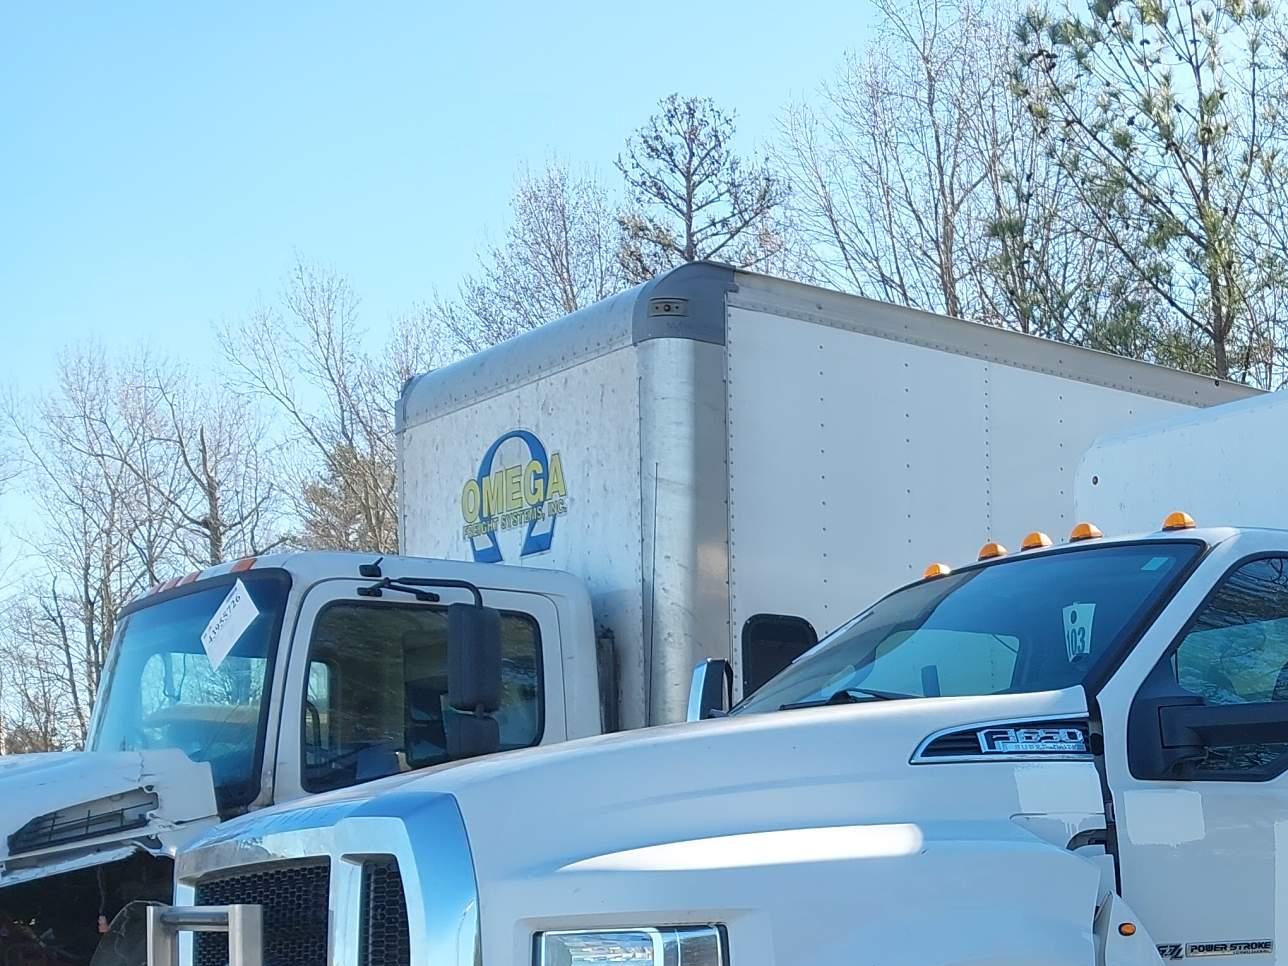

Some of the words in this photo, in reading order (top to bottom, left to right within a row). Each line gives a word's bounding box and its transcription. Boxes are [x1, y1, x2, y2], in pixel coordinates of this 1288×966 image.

[461, 452, 567, 524] OMEGA
[463, 516, 498, 540] FREIGHT
[500, 505, 545, 530] SYSTEMS,
[1190, 943, 1228, 953] POWER
[1229, 941, 1272, 951] STROKE
